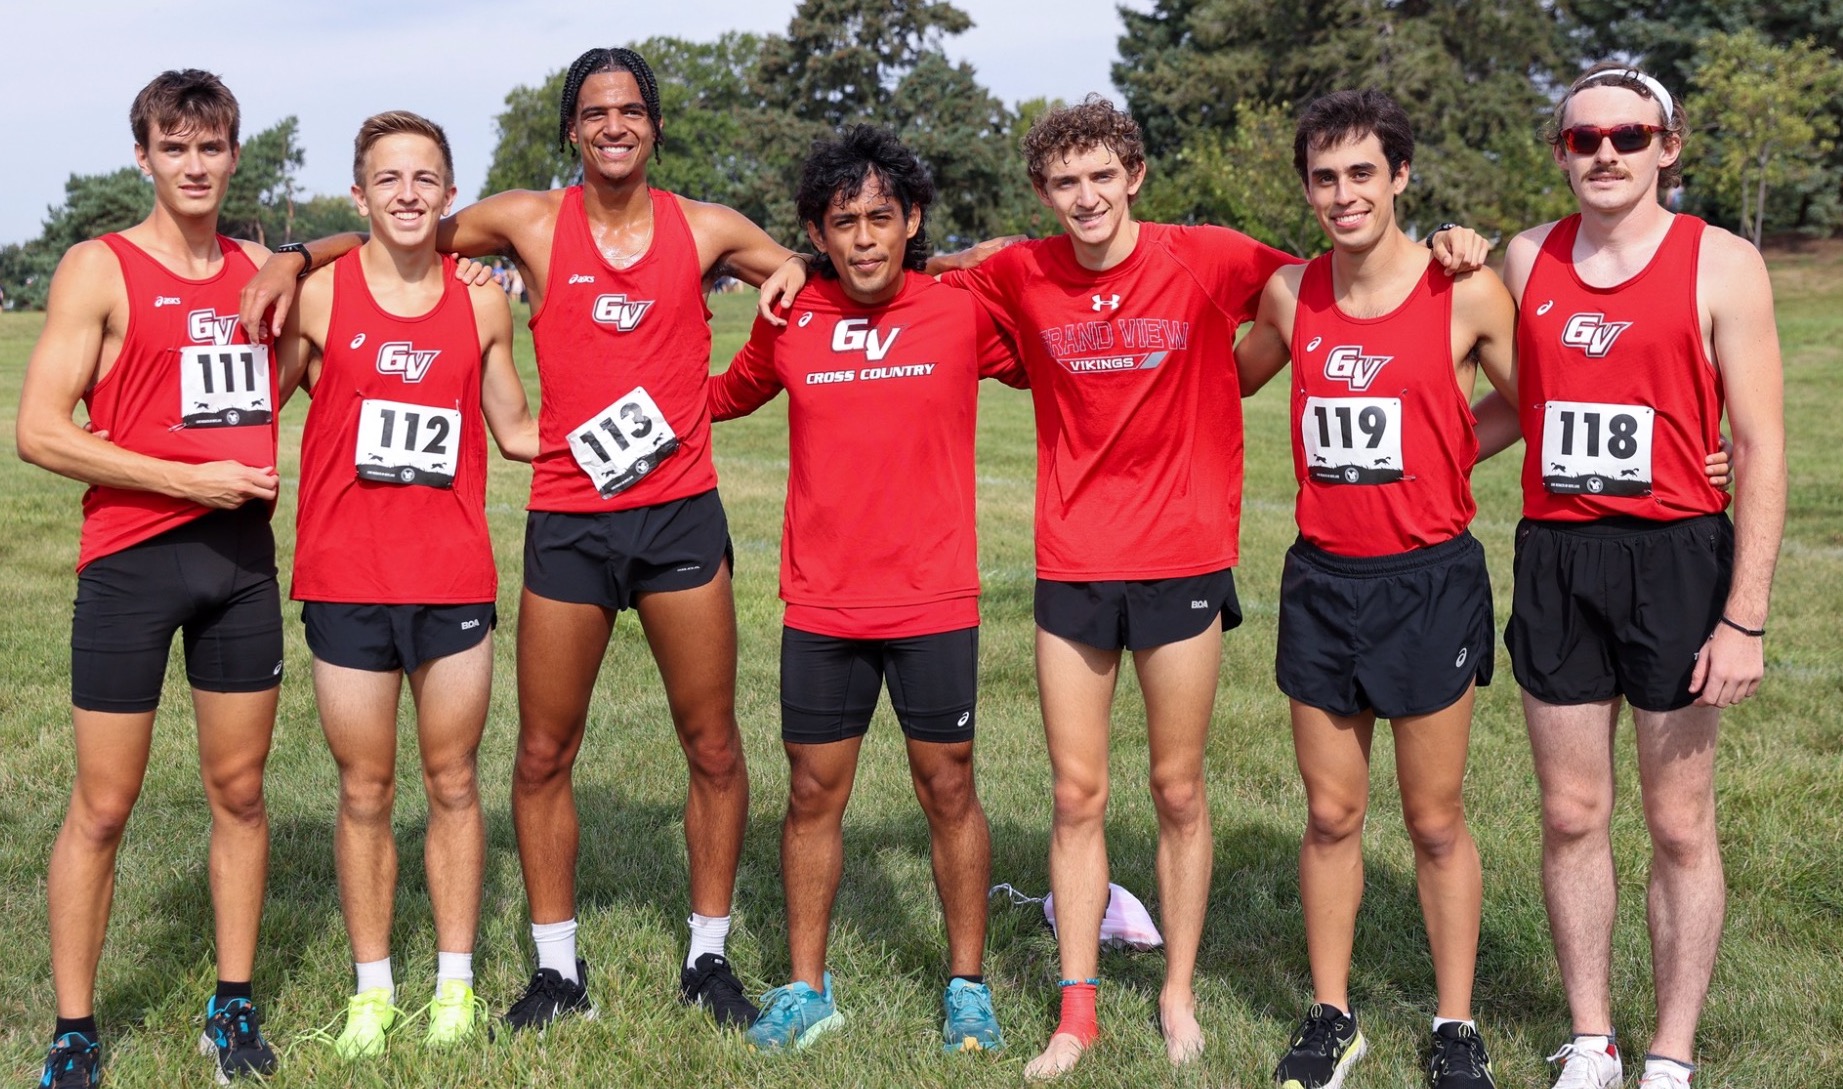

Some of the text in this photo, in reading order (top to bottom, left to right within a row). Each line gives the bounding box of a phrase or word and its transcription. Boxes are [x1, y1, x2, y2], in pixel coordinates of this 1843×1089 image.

[188, 308, 240, 345] GV
[592, 294, 656, 331] GV
[831, 318, 901, 361] GV
[1118, 318, 1189, 350] VIEW
[1561, 312, 1634, 357] GV
[197, 352, 255, 394] 111
[376, 341, 442, 383] GV
[806, 363, 936, 385] CROSS COUNTRY
[1070, 357, 1134, 372] VIKINGS
[1324, 345, 1395, 391] GV
[380, 408, 451, 455] 112
[579, 402, 653, 464] 113
[1314, 405, 1387, 449] 119
[1560, 411, 1638, 459] 118
[461, 618, 480, 630] BOA
[1191, 600, 1208, 609] BOA
